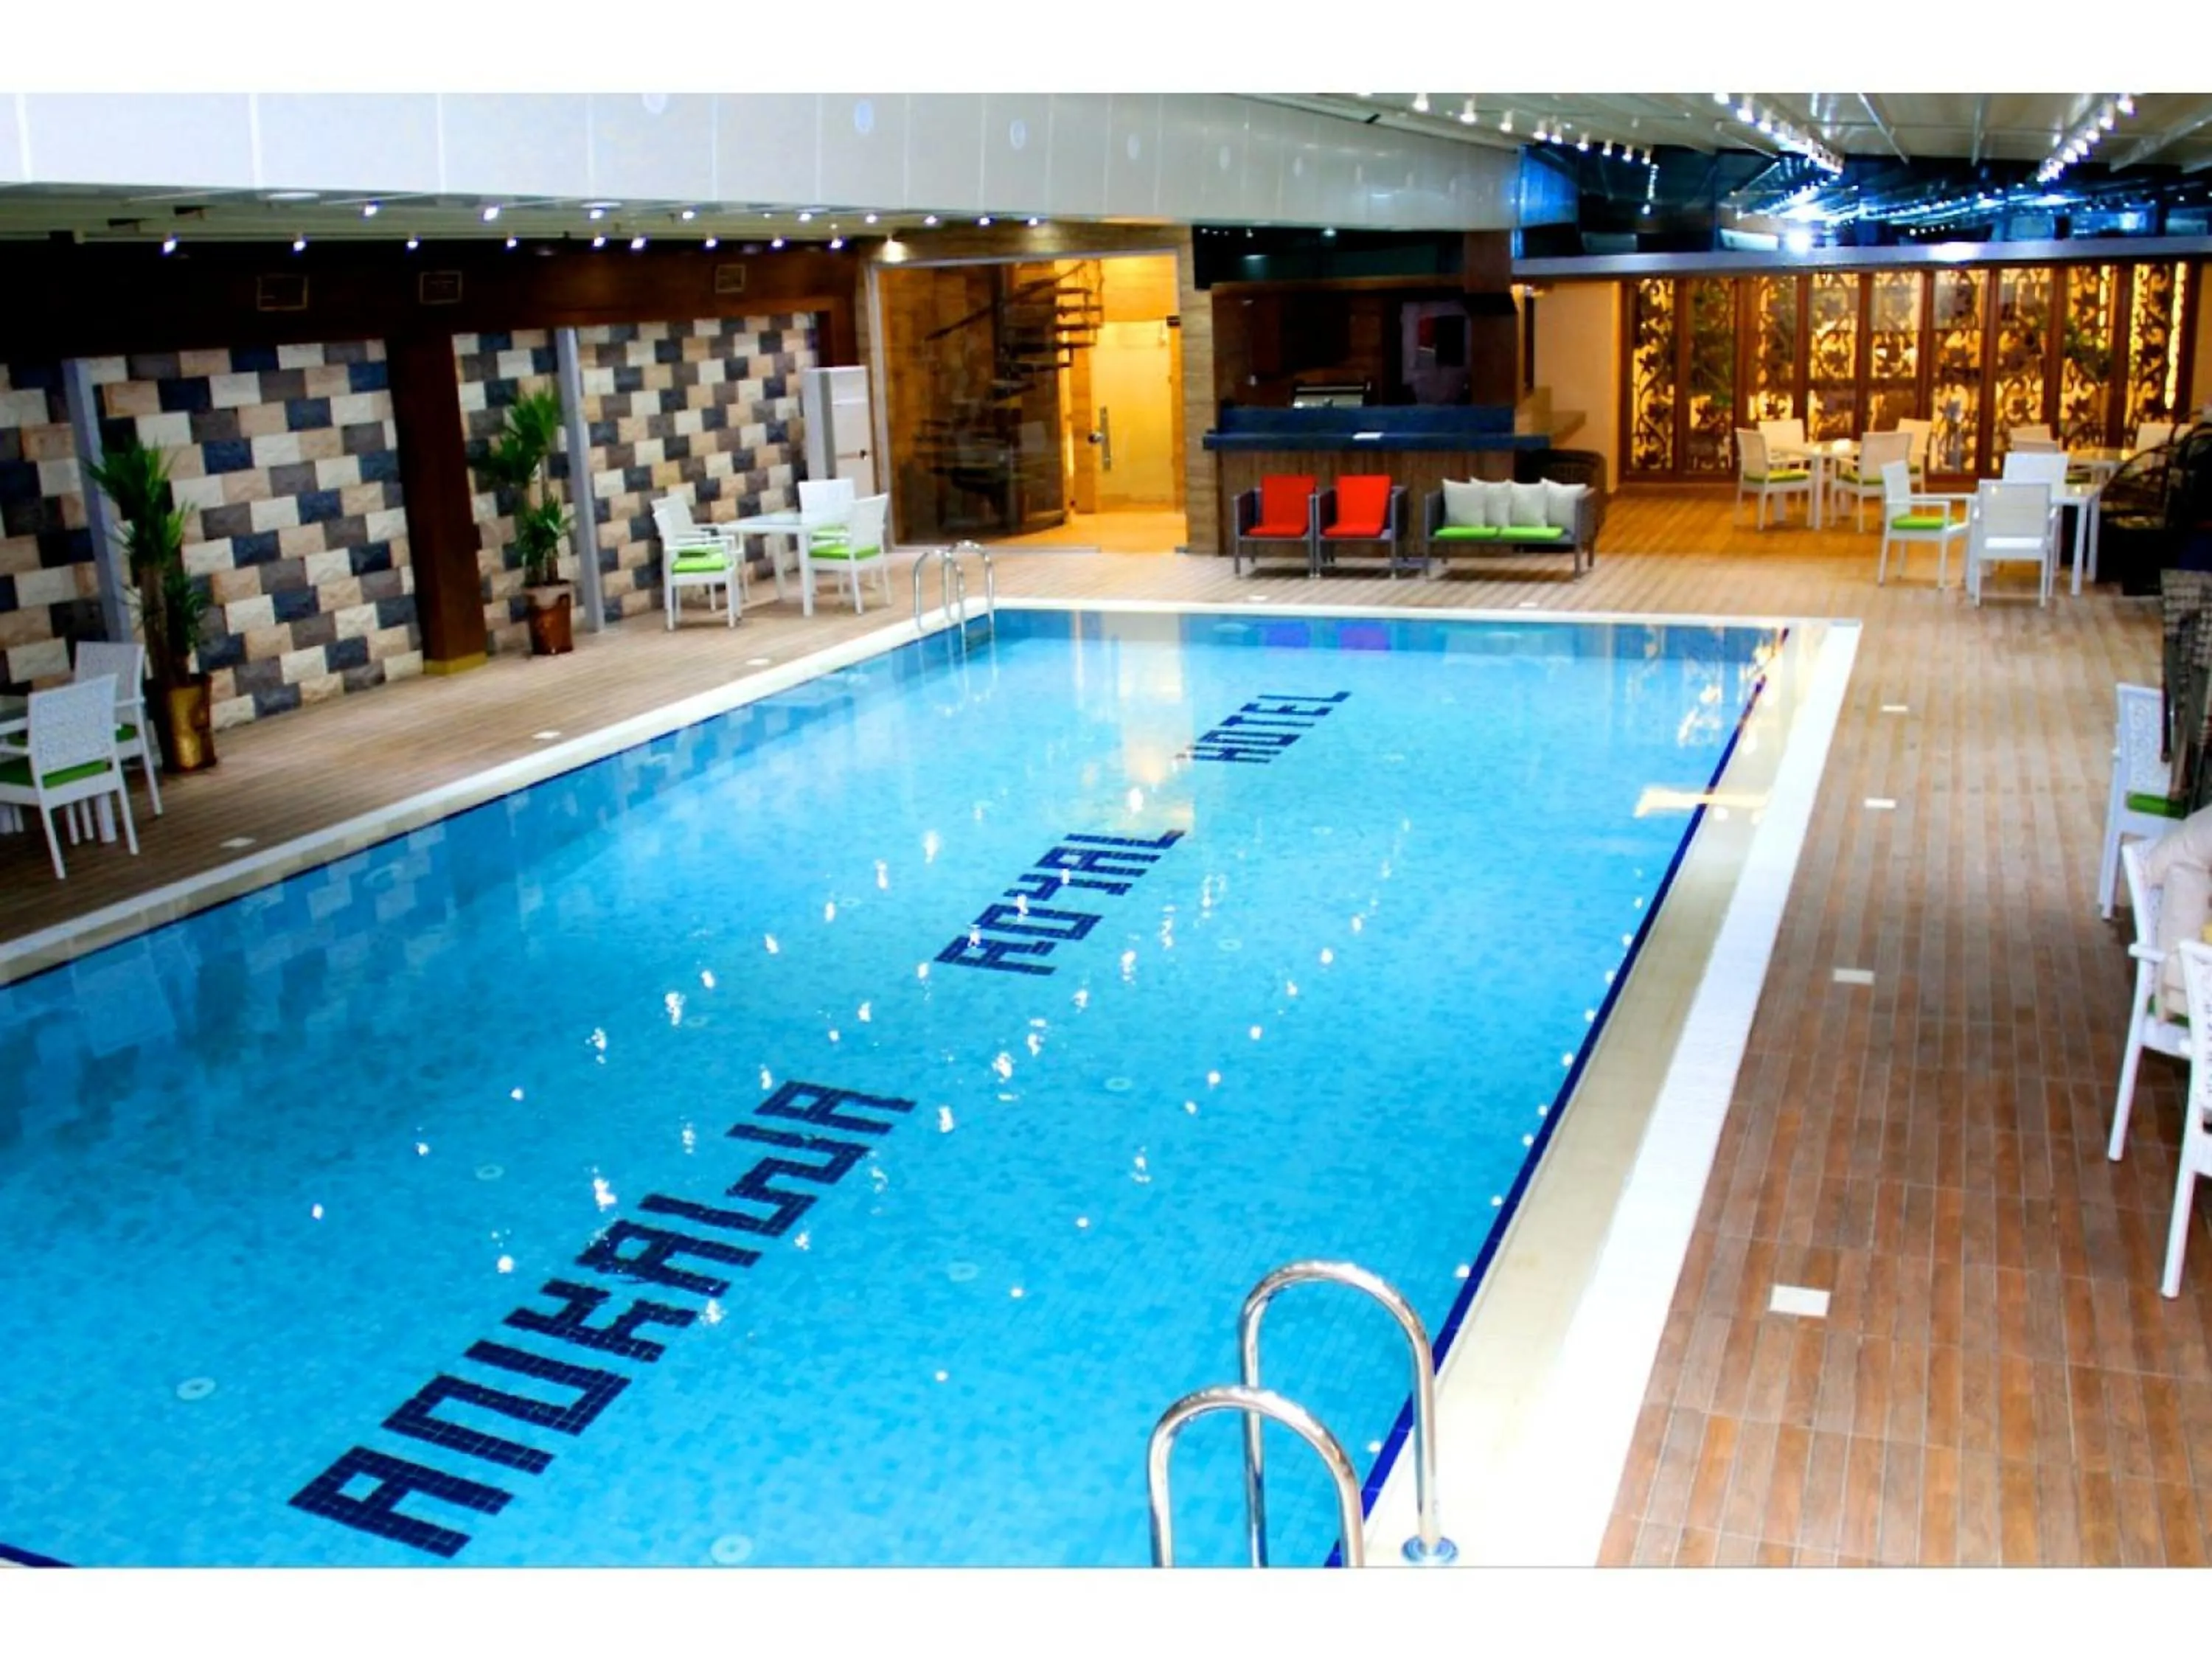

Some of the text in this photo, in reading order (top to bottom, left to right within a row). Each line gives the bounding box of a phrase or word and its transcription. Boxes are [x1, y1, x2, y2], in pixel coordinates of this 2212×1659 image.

[288, 691, 1352, 1558] ANKAWA ROYAL HOTEL
